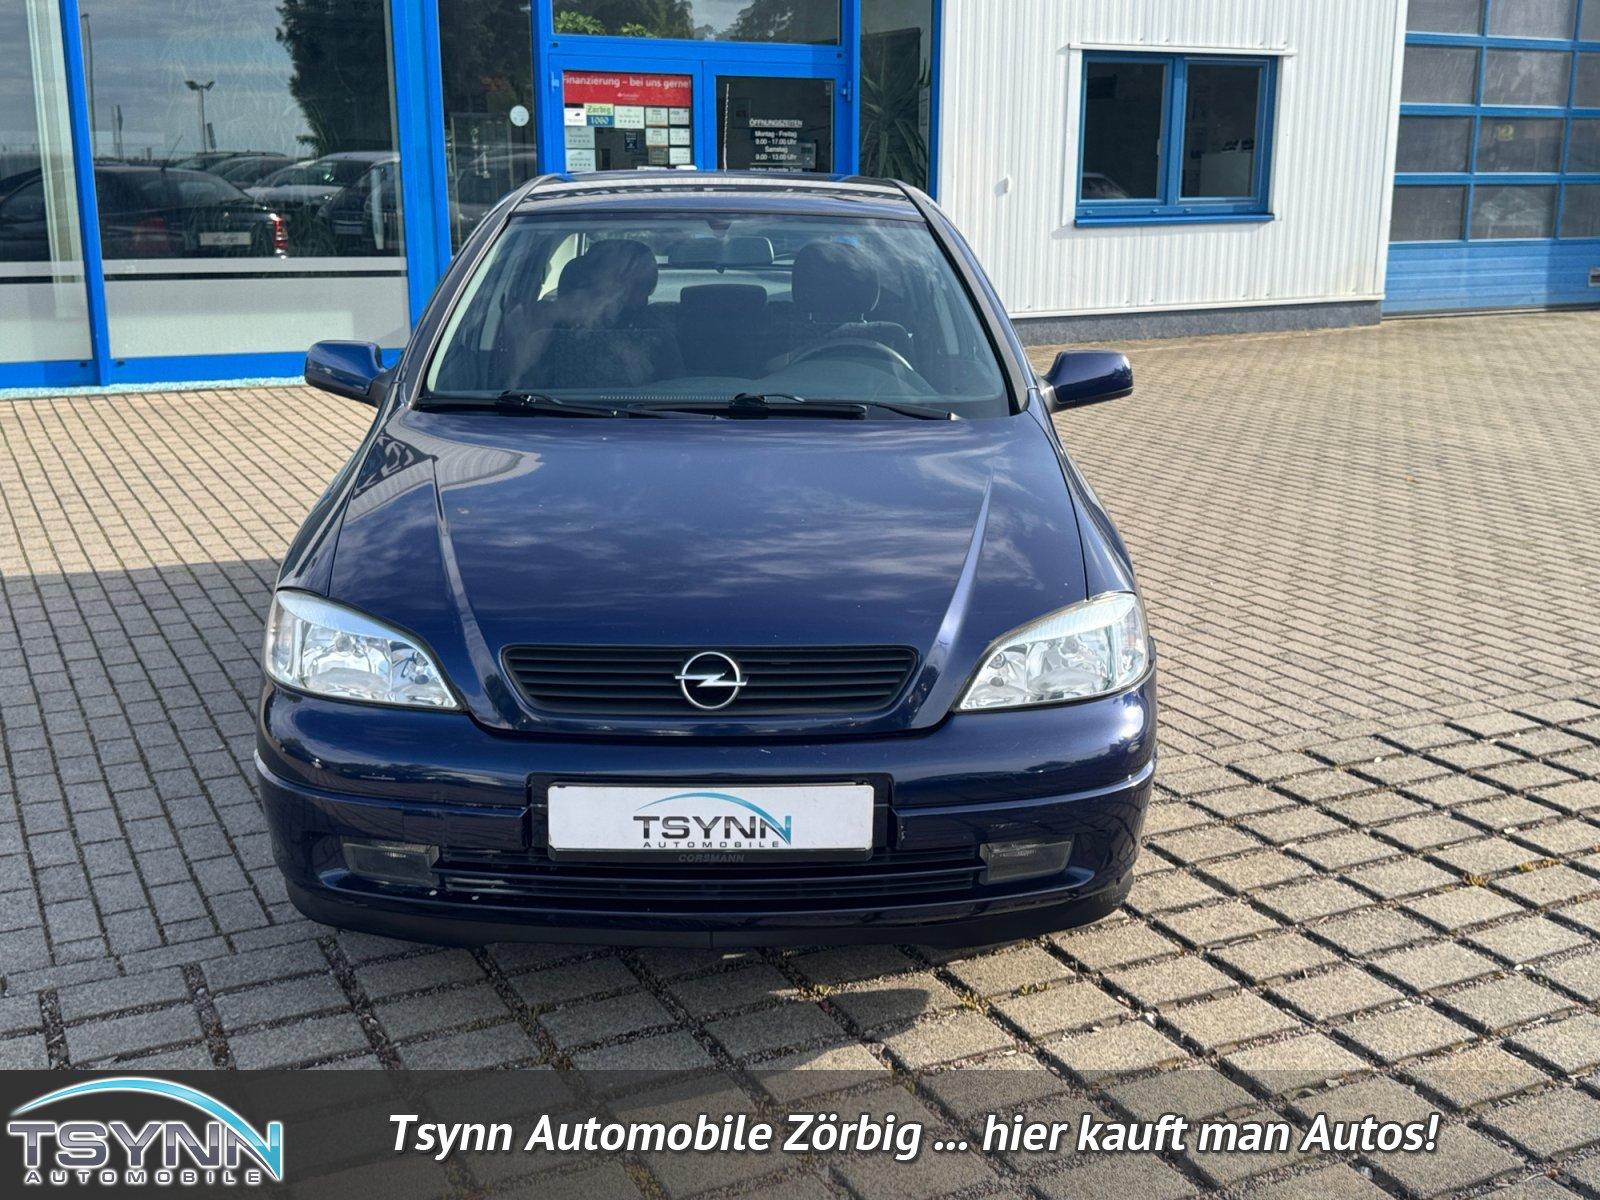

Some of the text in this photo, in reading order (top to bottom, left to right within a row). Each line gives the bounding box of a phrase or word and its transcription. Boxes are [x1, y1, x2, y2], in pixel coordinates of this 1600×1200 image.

[629, 76, 644, 87] bei
[646, 79, 662, 88] uns
[749, 118, 803, 127] ÖFFNUNGSZEITEN
[755, 131, 775, 139] Montag
[779, 131, 797, 139] Freitag
[765, 146, 788, 154] Samstag
[633, 816, 791, 845] TSYNN
